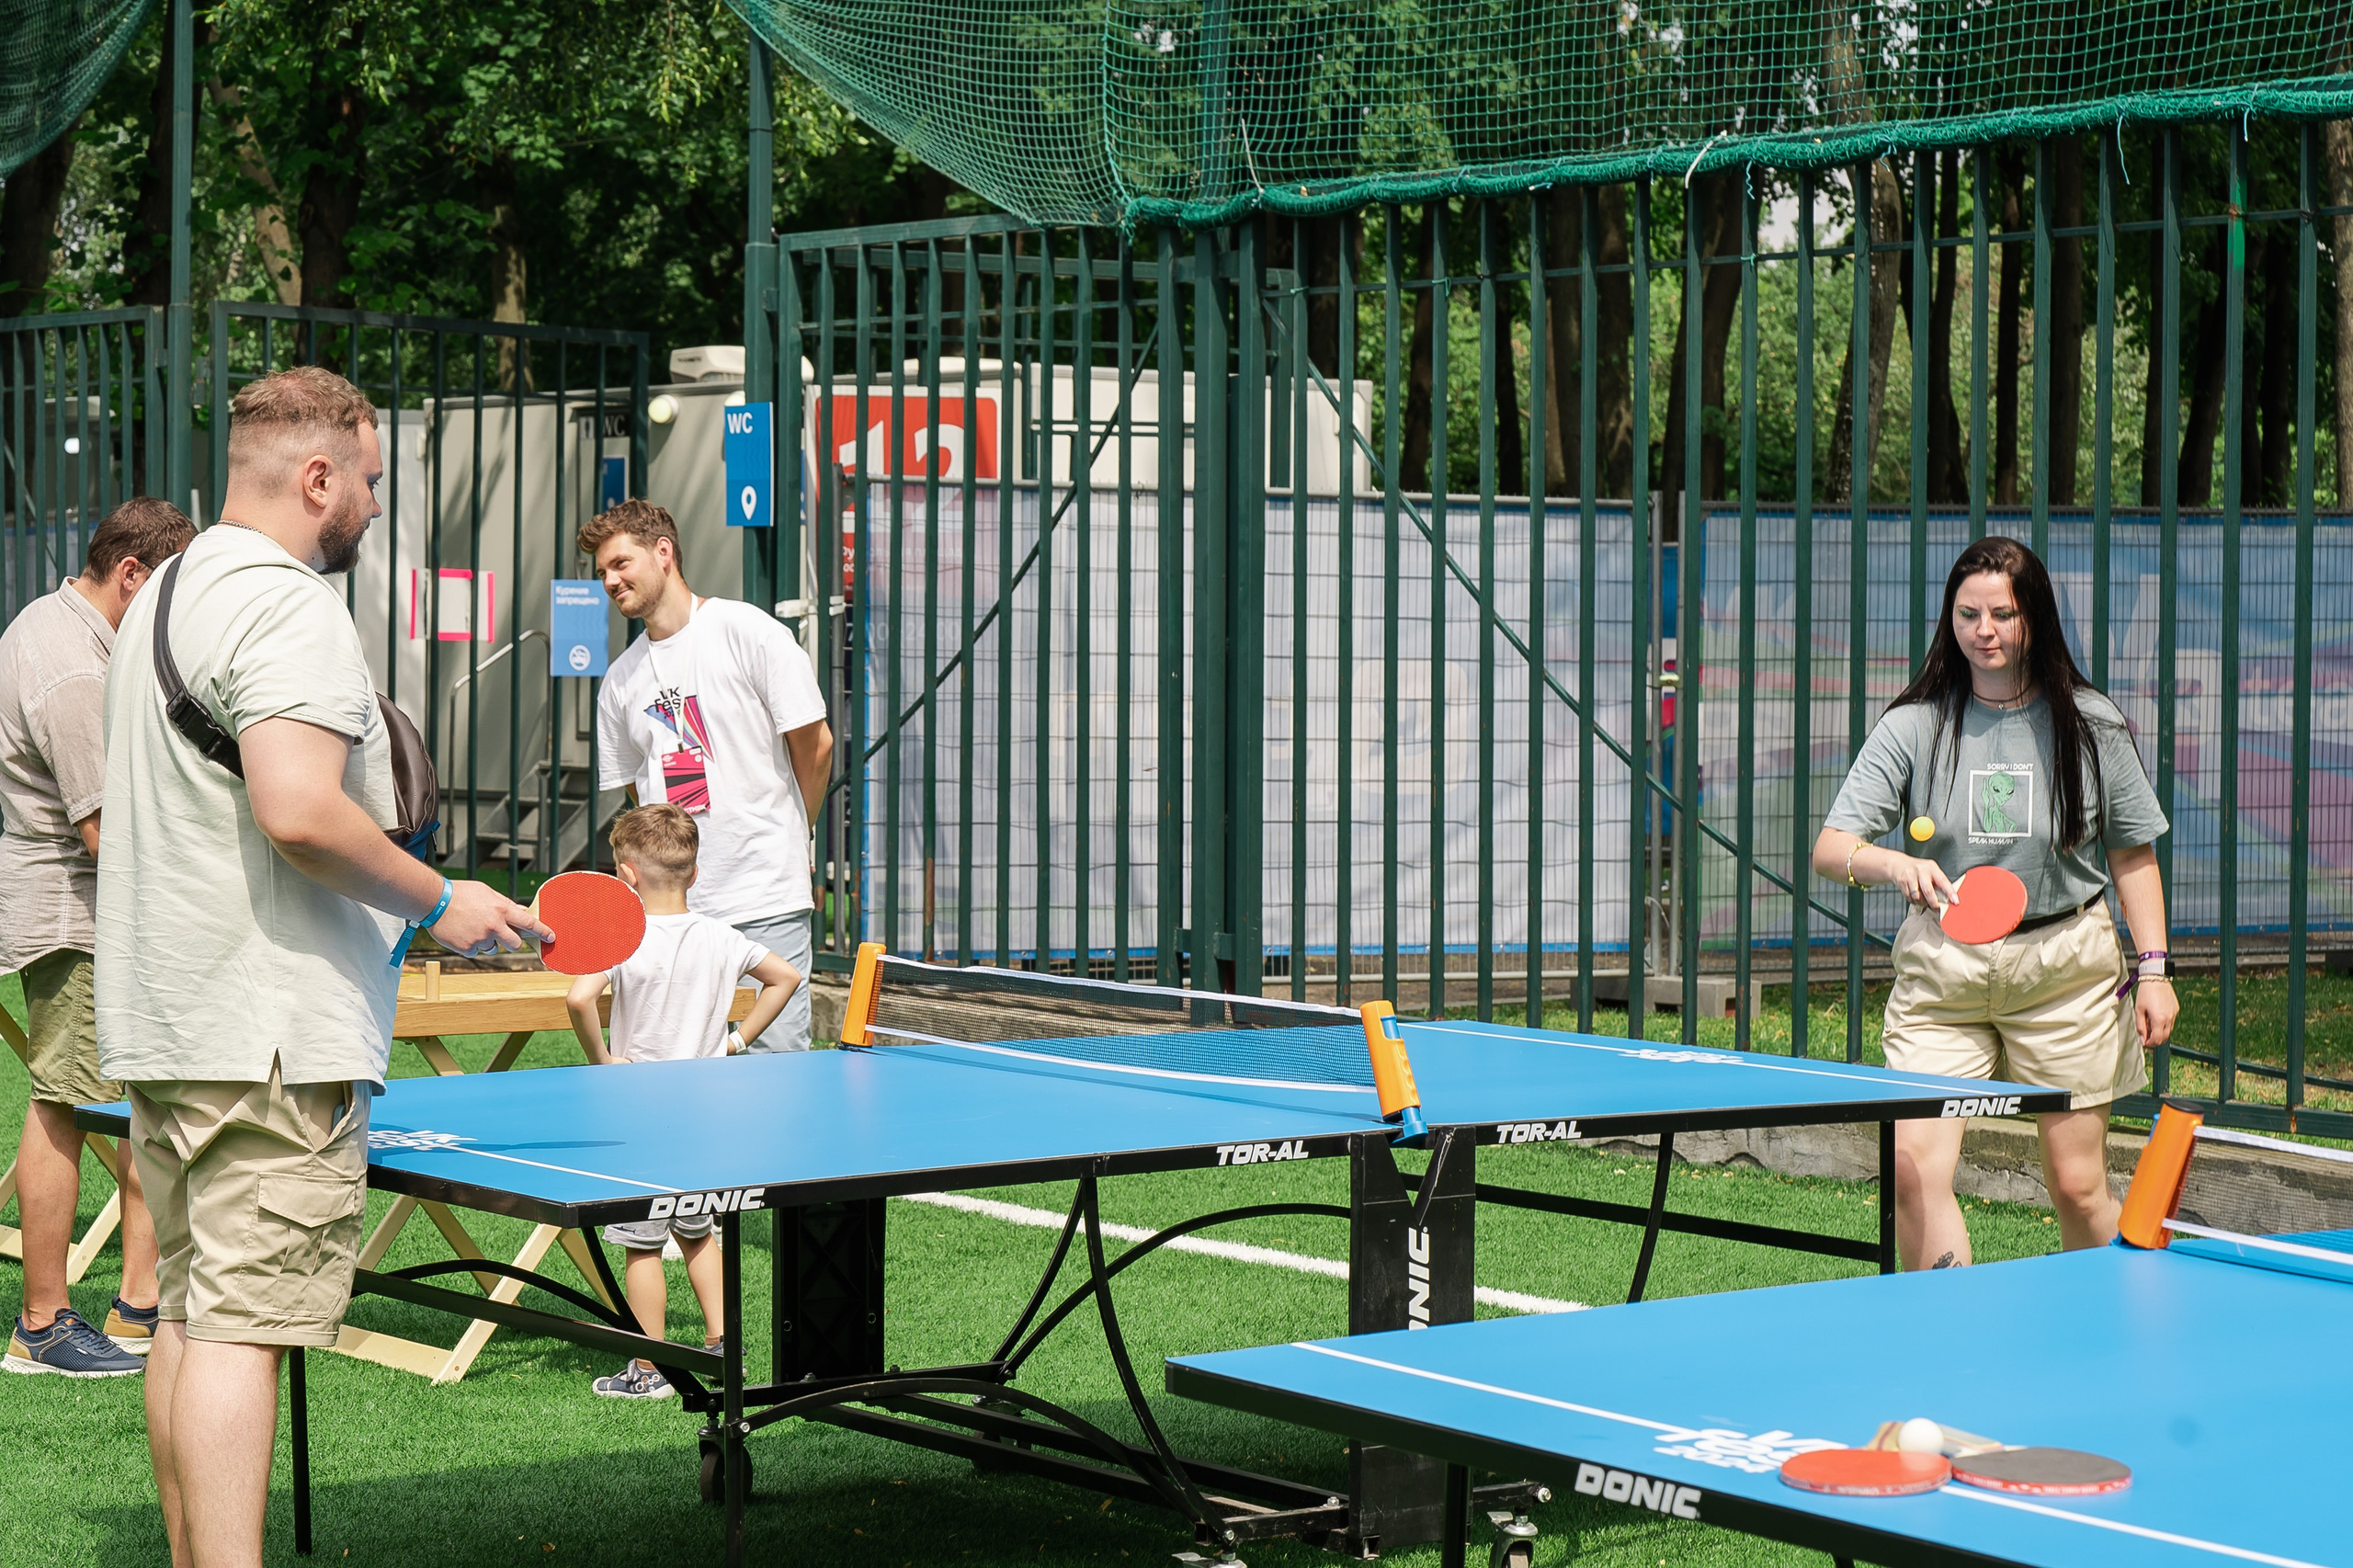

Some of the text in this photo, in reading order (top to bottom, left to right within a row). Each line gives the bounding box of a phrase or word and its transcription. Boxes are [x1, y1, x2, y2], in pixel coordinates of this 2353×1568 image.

[727, 412, 753, 434] WC
[1987, 763, 2009, 771] SORRY
[1940, 1096, 2021, 1118] DONIC
[1496, 1120, 1582, 1144] TOR-AL
[1216, 1140, 1310, 1165] TOR-AL
[647, 1187, 766, 1220] DONIC
[1408, 1226, 1429, 1331] NIC
[1574, 1462, 1701, 1520] DONIC
